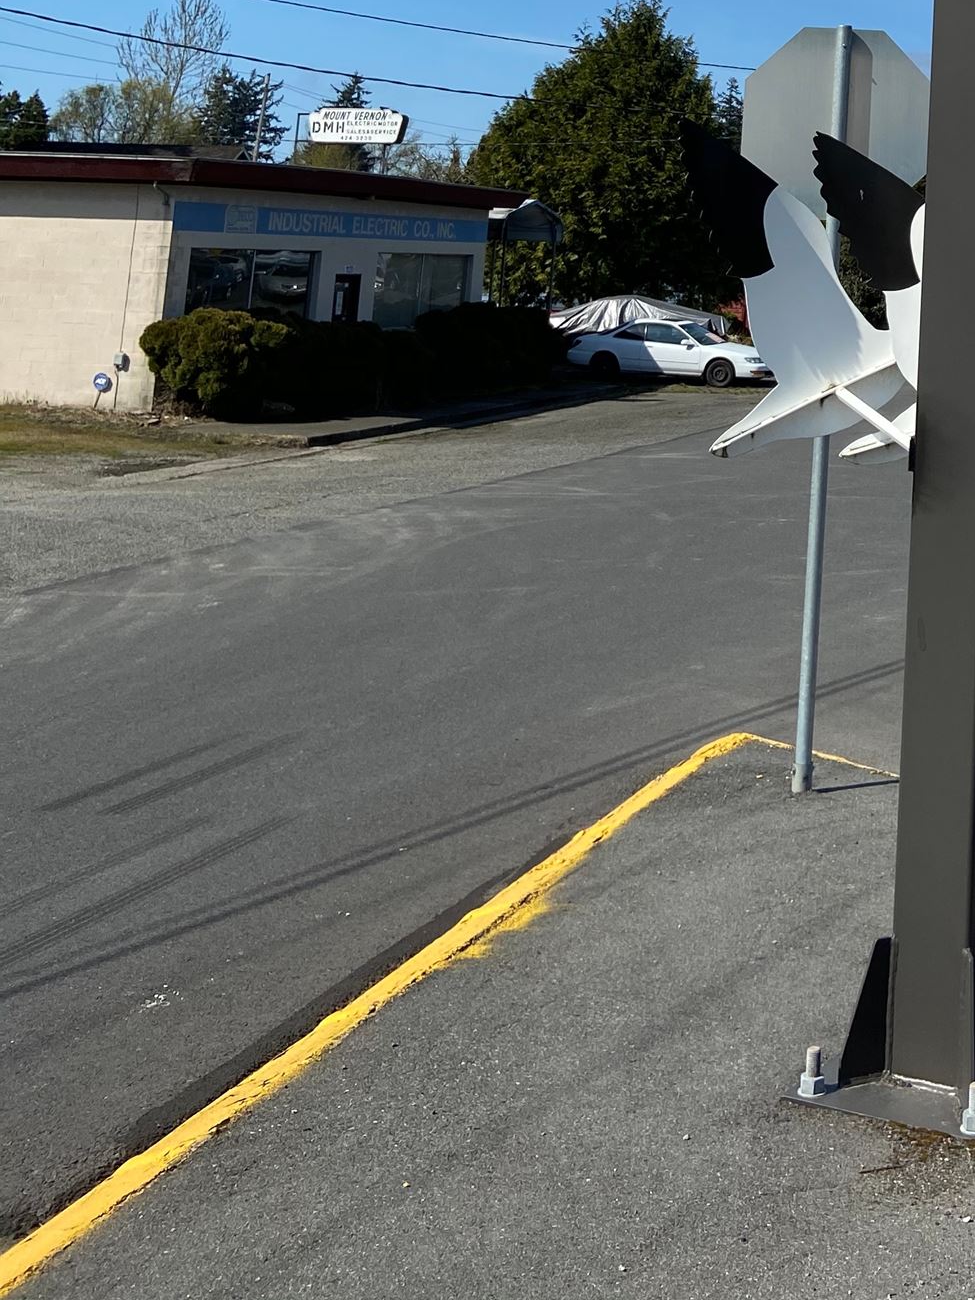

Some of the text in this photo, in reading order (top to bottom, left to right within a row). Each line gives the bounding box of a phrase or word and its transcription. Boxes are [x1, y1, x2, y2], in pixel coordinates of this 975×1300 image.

[322, 111, 389, 121] MOUNT VERNON
[312, 121, 345, 133] DMH
[268, 211, 346, 234] INDUSTRIAL
[352, 216, 408, 238] ELECTRIC
